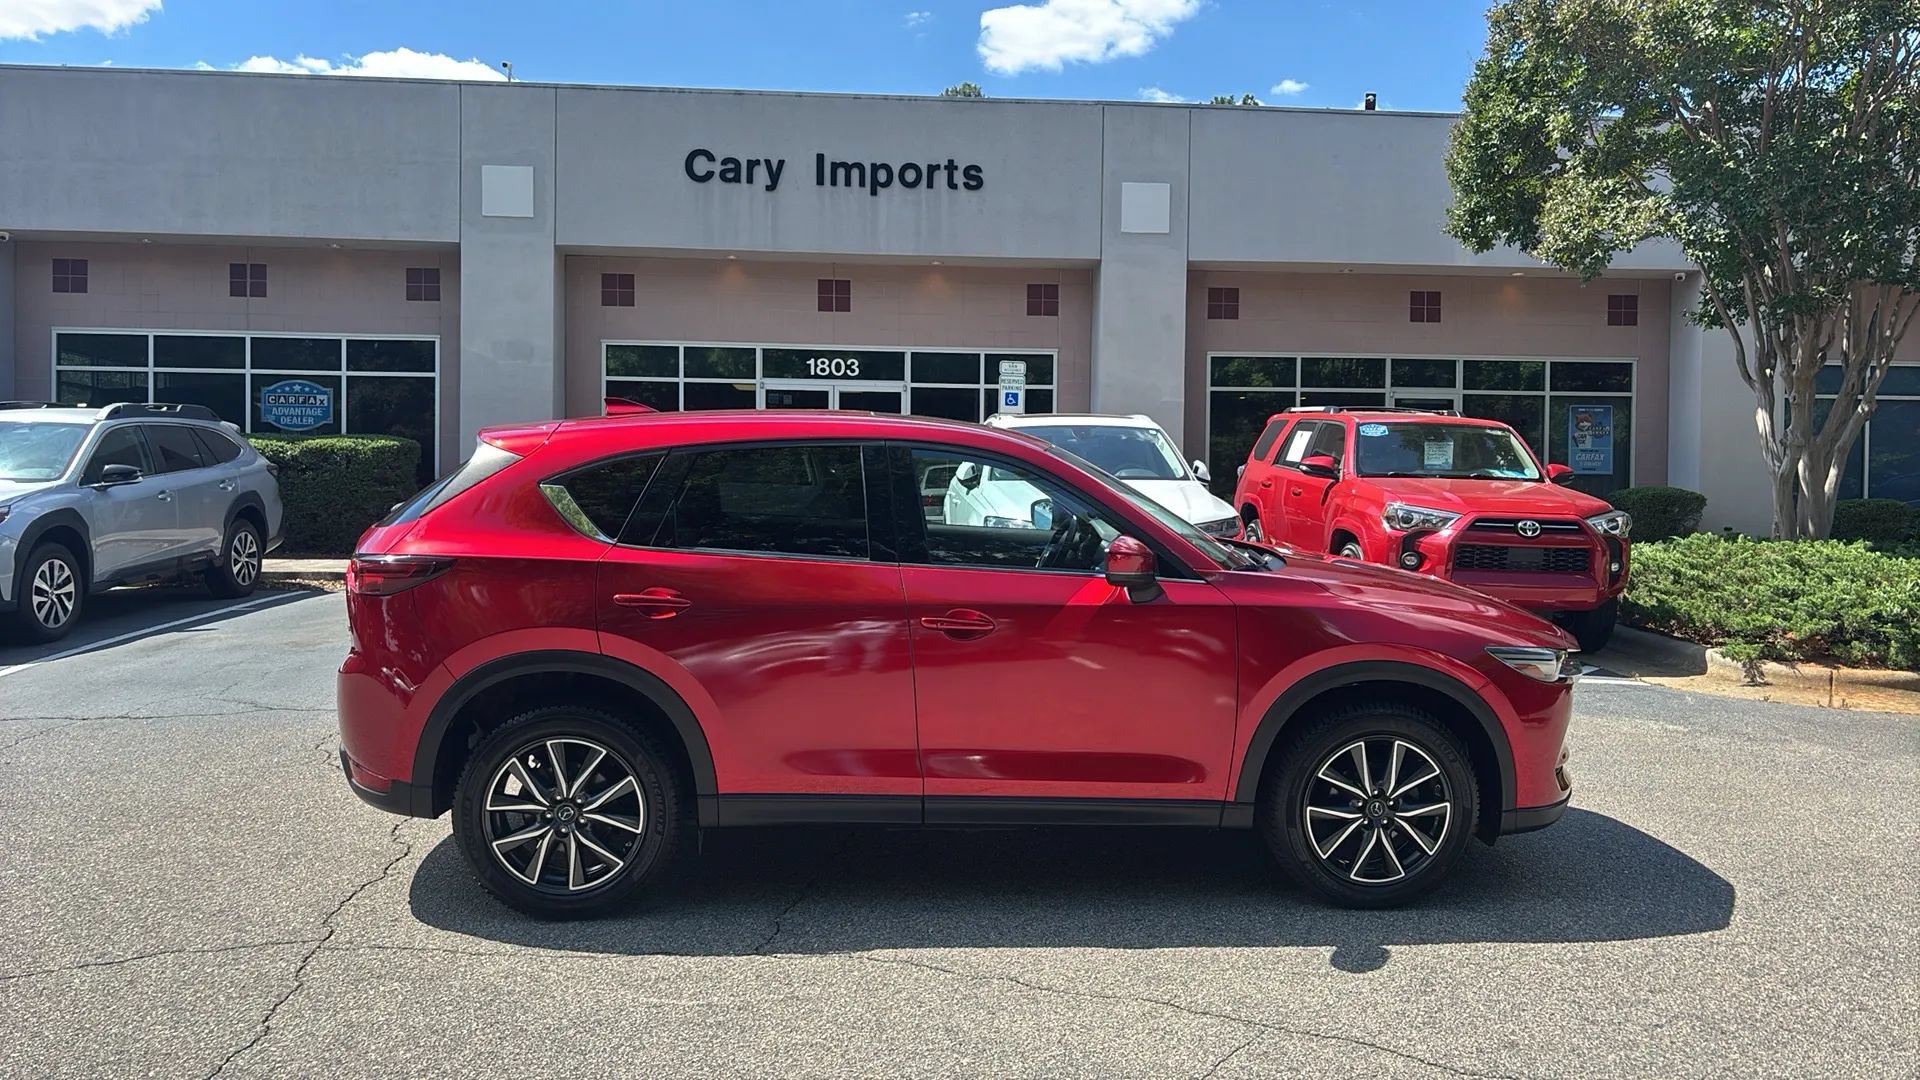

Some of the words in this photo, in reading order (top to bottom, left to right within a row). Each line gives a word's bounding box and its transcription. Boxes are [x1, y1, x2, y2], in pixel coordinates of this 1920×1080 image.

[684, 148, 786, 192] Cary
[815, 153, 985, 197] Imports
[806, 358, 860, 377] 1803
[267, 395, 327, 406] CARFAX
[271, 407, 323, 416] ADVANTAGE
[280, 416, 315, 425] DEALER
[1575, 453, 1605, 462] CARFAX
